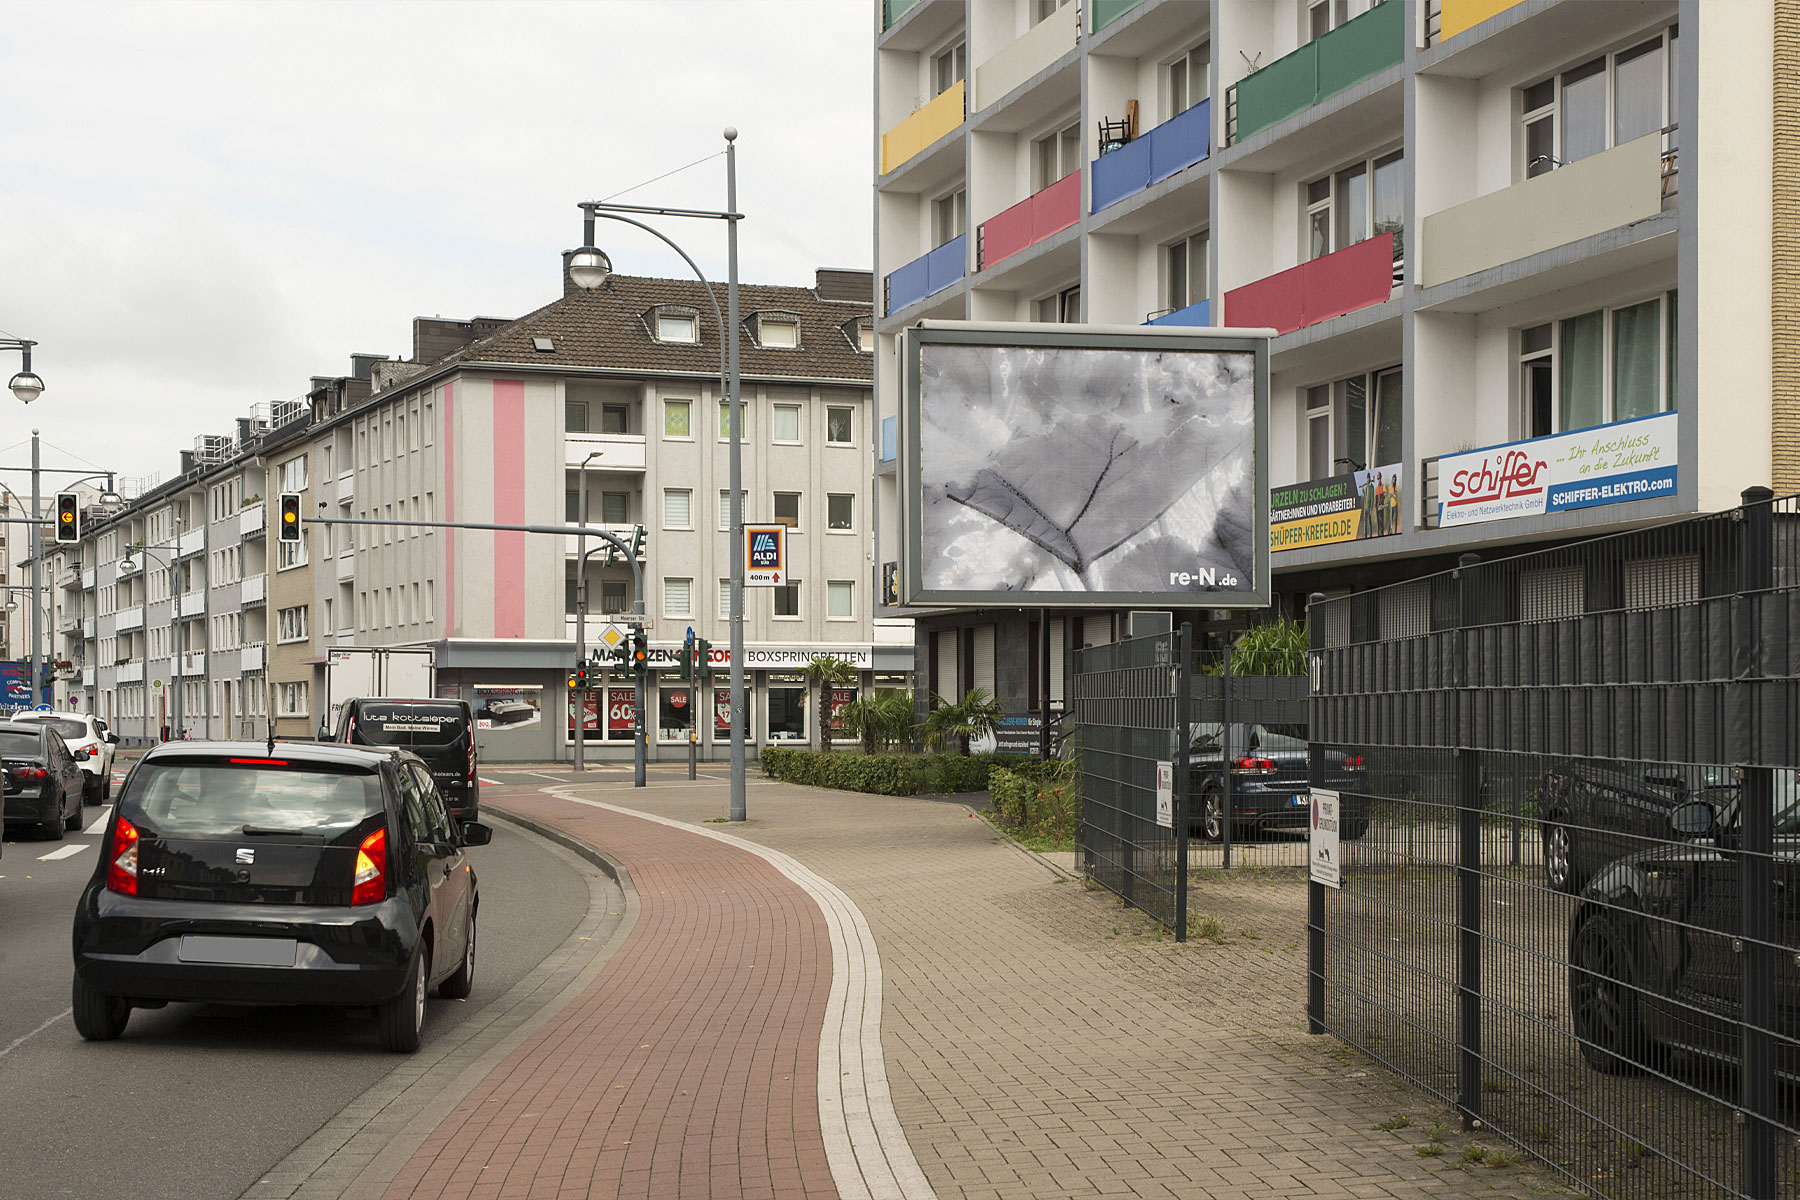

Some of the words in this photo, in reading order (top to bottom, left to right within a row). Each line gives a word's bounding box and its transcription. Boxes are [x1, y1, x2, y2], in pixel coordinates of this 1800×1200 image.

[1568, 445, 1587, 461] Ihr
[1591, 434, 1650, 456] Anschluss
[1579, 464, 1591, 474] an
[1594, 457, 1609, 471] die
[1612, 446, 1661, 469] Zukunft
[1299, 489, 1309, 503] ZU
[1309, 483, 1343, 502] SCHLAGEN
[1552, 478, 1673, 506] SCHIFFER-ELEKTRO.com
[1307, 503, 1319, 516] UND
[1318, 498, 1352, 514] VORARBEITER
[1446, 510, 1467, 521] Elektro-
[1467, 508, 1478, 517] und
[1480, 502, 1524, 517] Netzwerktechnik
[1525, 498, 1544, 510] GmbH
[753, 552, 777, 560] ALDI
[592, 649, 673, 662] MAZEN
[571, 692, 596, 701] SLE
[611, 692, 636, 701] SALE
[719, 692, 731, 701] SA
[832, 692, 850, 701] ALE
